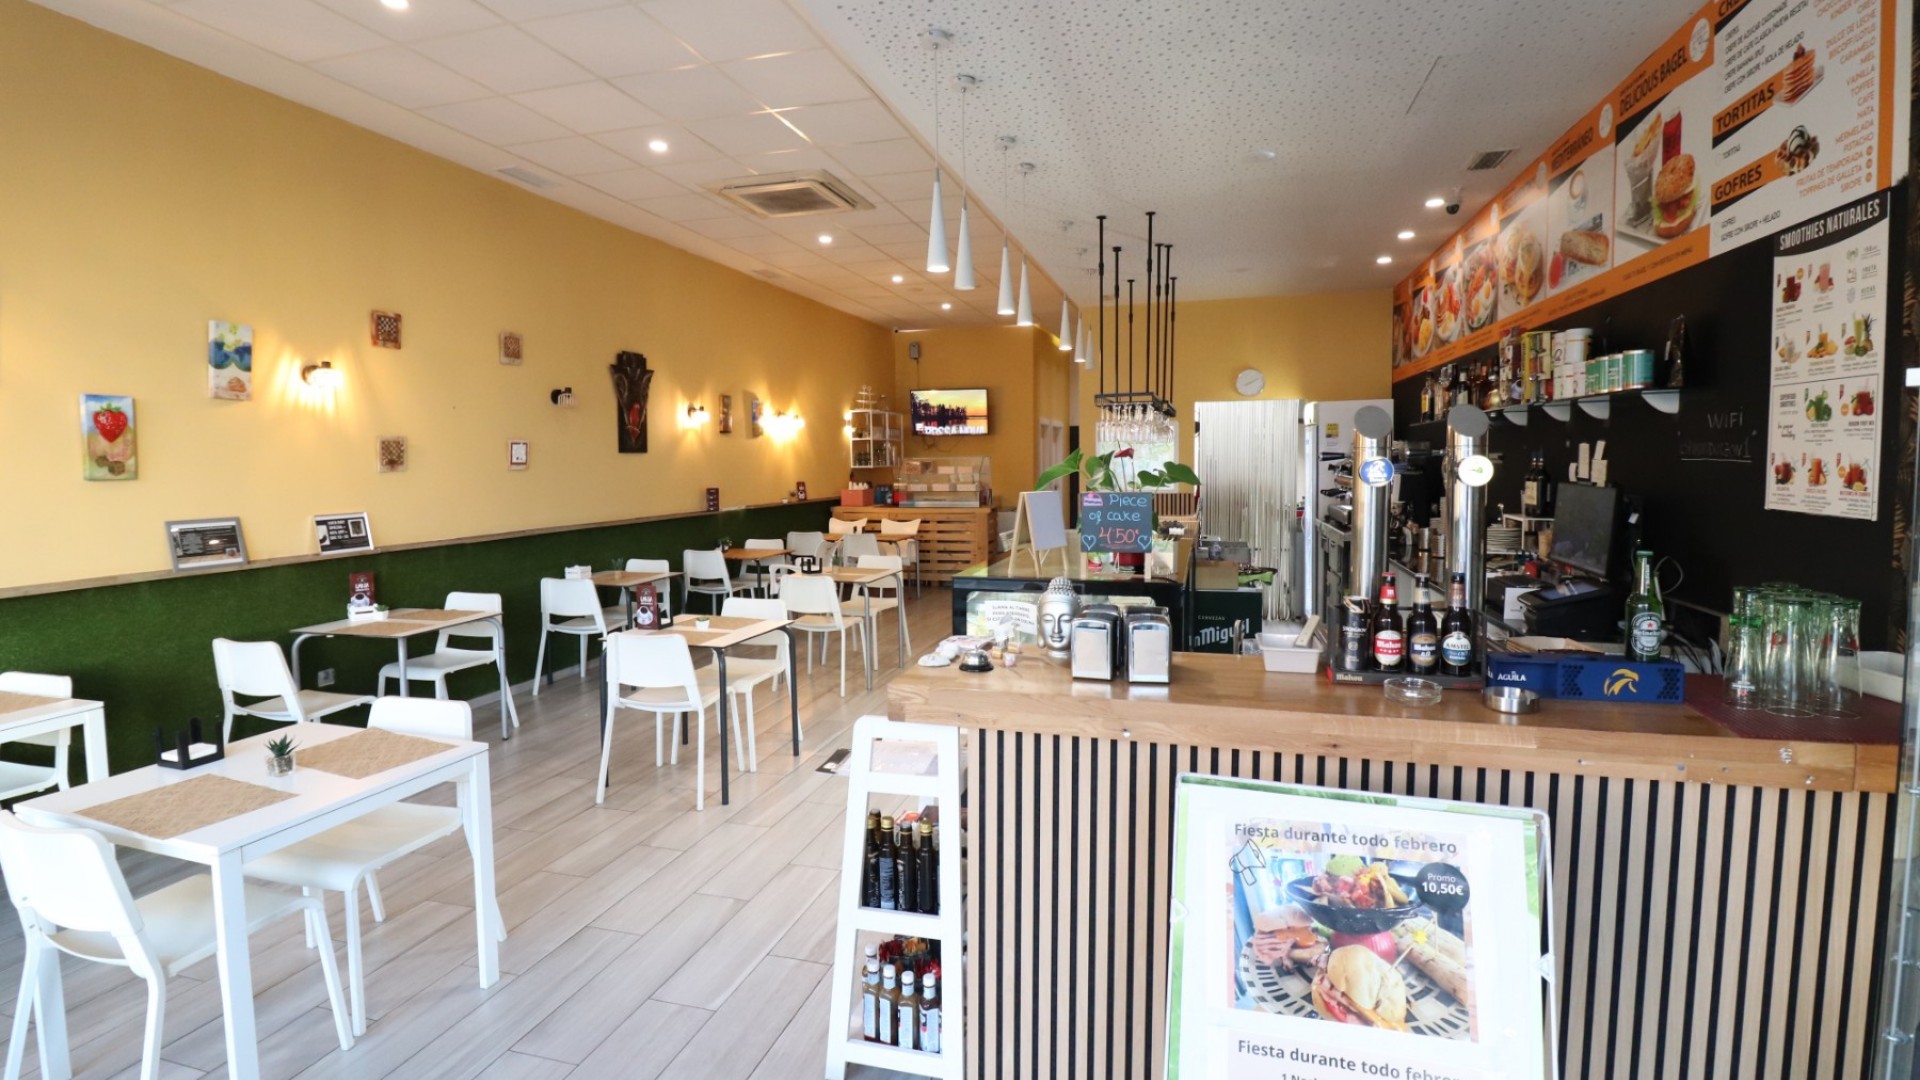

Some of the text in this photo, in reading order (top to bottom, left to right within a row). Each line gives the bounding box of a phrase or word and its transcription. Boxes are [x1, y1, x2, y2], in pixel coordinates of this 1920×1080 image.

[1619, 71, 1659, 117] DELICIOUS
[1660, 47, 1688, 83] BAGEL
[1716, 83, 1775, 133] TORTITAS
[1715, 164, 1763, 200] GOFRES
[1779, 198, 1880, 250] SMOOTHIES NATURALES
[1109, 493, 1148, 507] Piece
[1088, 510, 1141, 525] of cake
[1376, 639, 1401, 649] Mahou
[1446, 642, 1470, 651] AMSTEL
[1336, 672, 1363, 682] Mahou
[1234, 822, 1457, 854] Fiesta durante todo febrero
[1427, 872, 1456, 884] Promo
[1421, 881, 1464, 896] 10,50€
[1238, 1040, 1285, 1059] Fiesta
[1289, 1048, 1356, 1072] durante
[1361, 1060, 1400, 1079] todo
